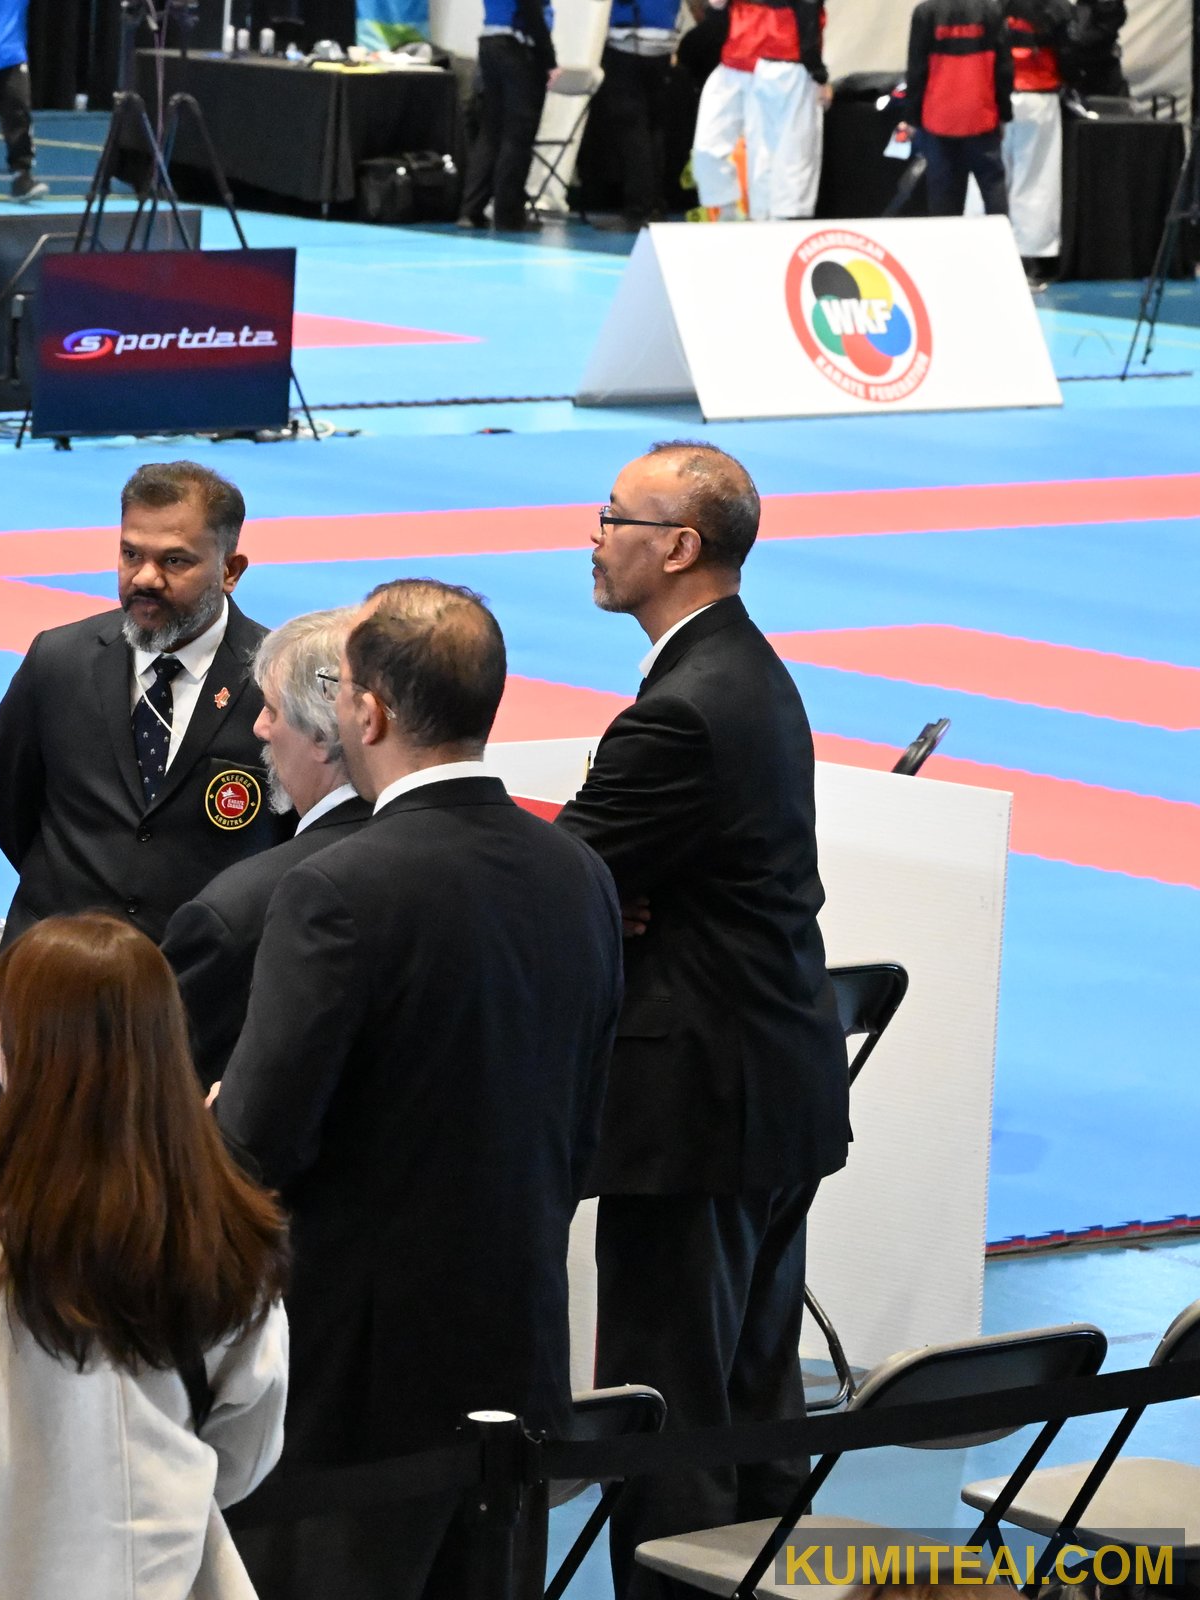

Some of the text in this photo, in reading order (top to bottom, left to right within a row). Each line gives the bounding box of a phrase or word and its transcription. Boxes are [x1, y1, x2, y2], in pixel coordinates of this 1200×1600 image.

[820, 298, 893, 336] WKF
[74, 326, 278, 355] sportdata
[221, 775, 252, 788] REFEREE
[214, 814, 243, 826] ARBITRE
